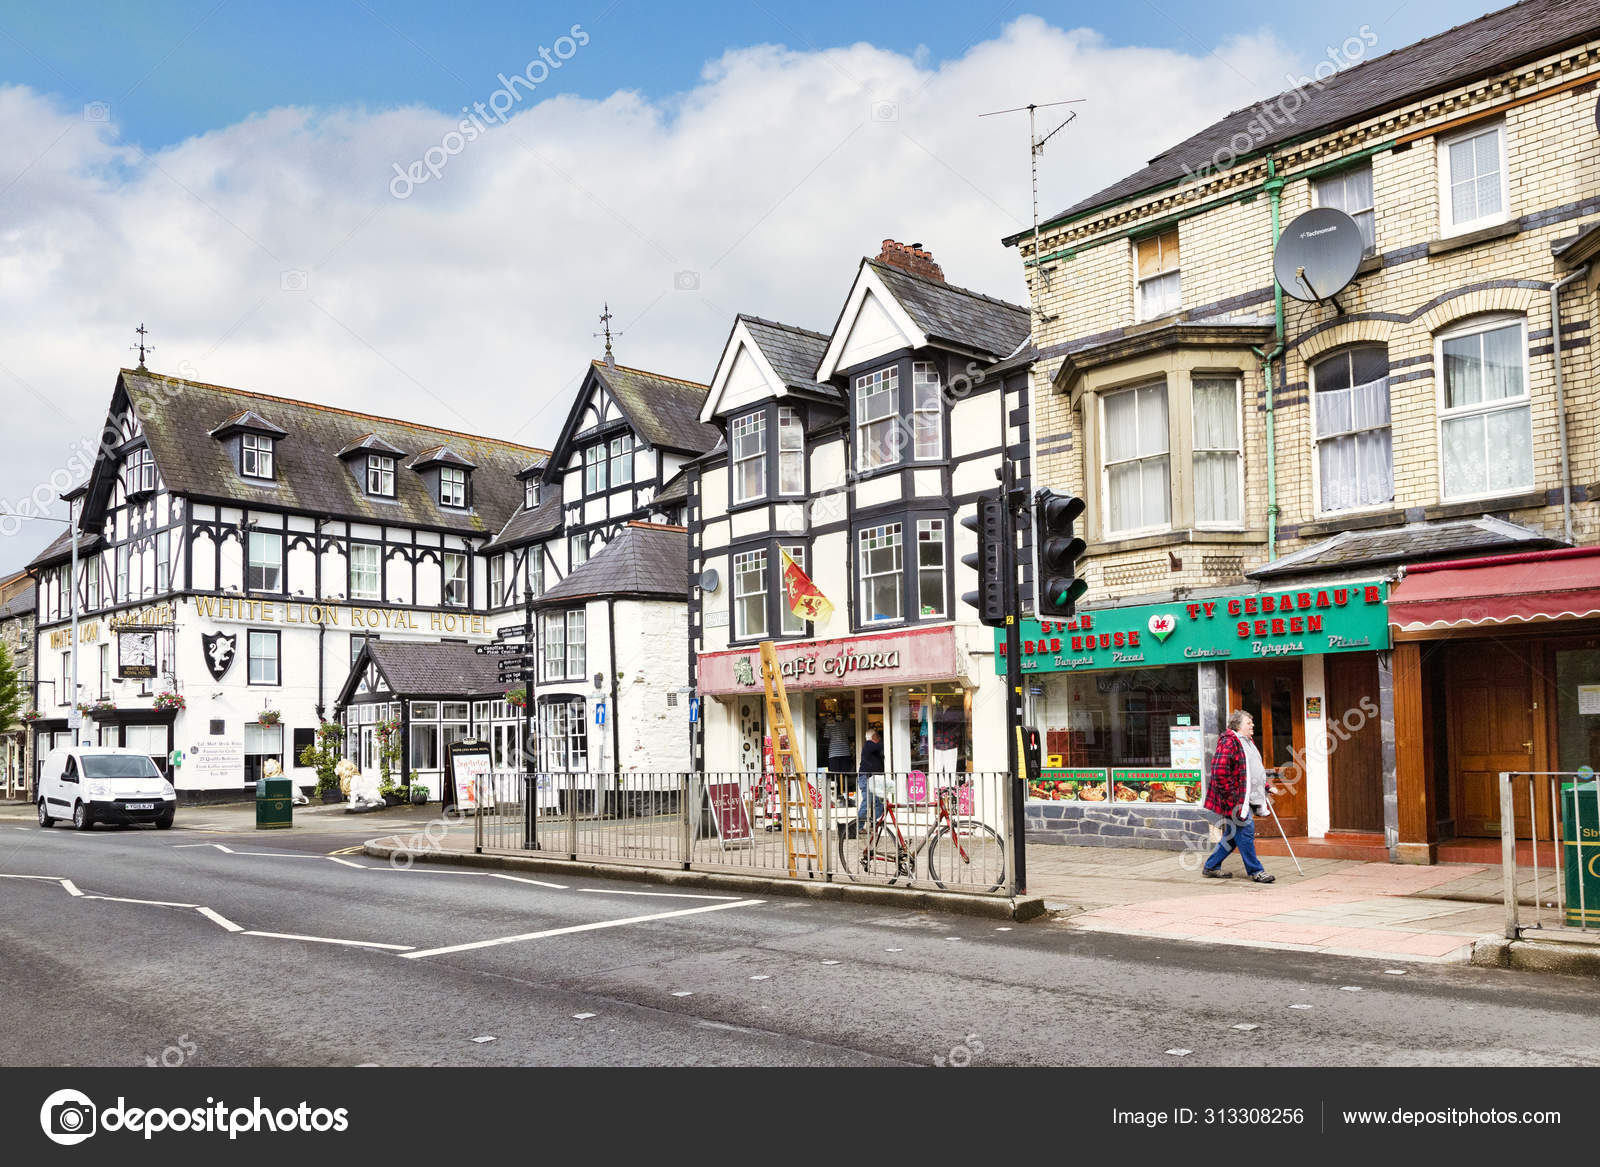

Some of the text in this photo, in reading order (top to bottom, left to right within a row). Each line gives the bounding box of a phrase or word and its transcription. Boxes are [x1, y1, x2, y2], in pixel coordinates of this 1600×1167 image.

[195, 595, 493, 634] WHITE LION ROYAL HOTEL
[1186, 586, 1381, 619] TY CEBABAU'R
[1041, 615, 1092, 633] STAR
[1237, 614, 1324, 637] SEREN
[999, 631, 1140, 656] KBAB HOUSE
[1054, 655, 1095, 668] Burgers
[1112, 651, 1145, 663] Pizzas
